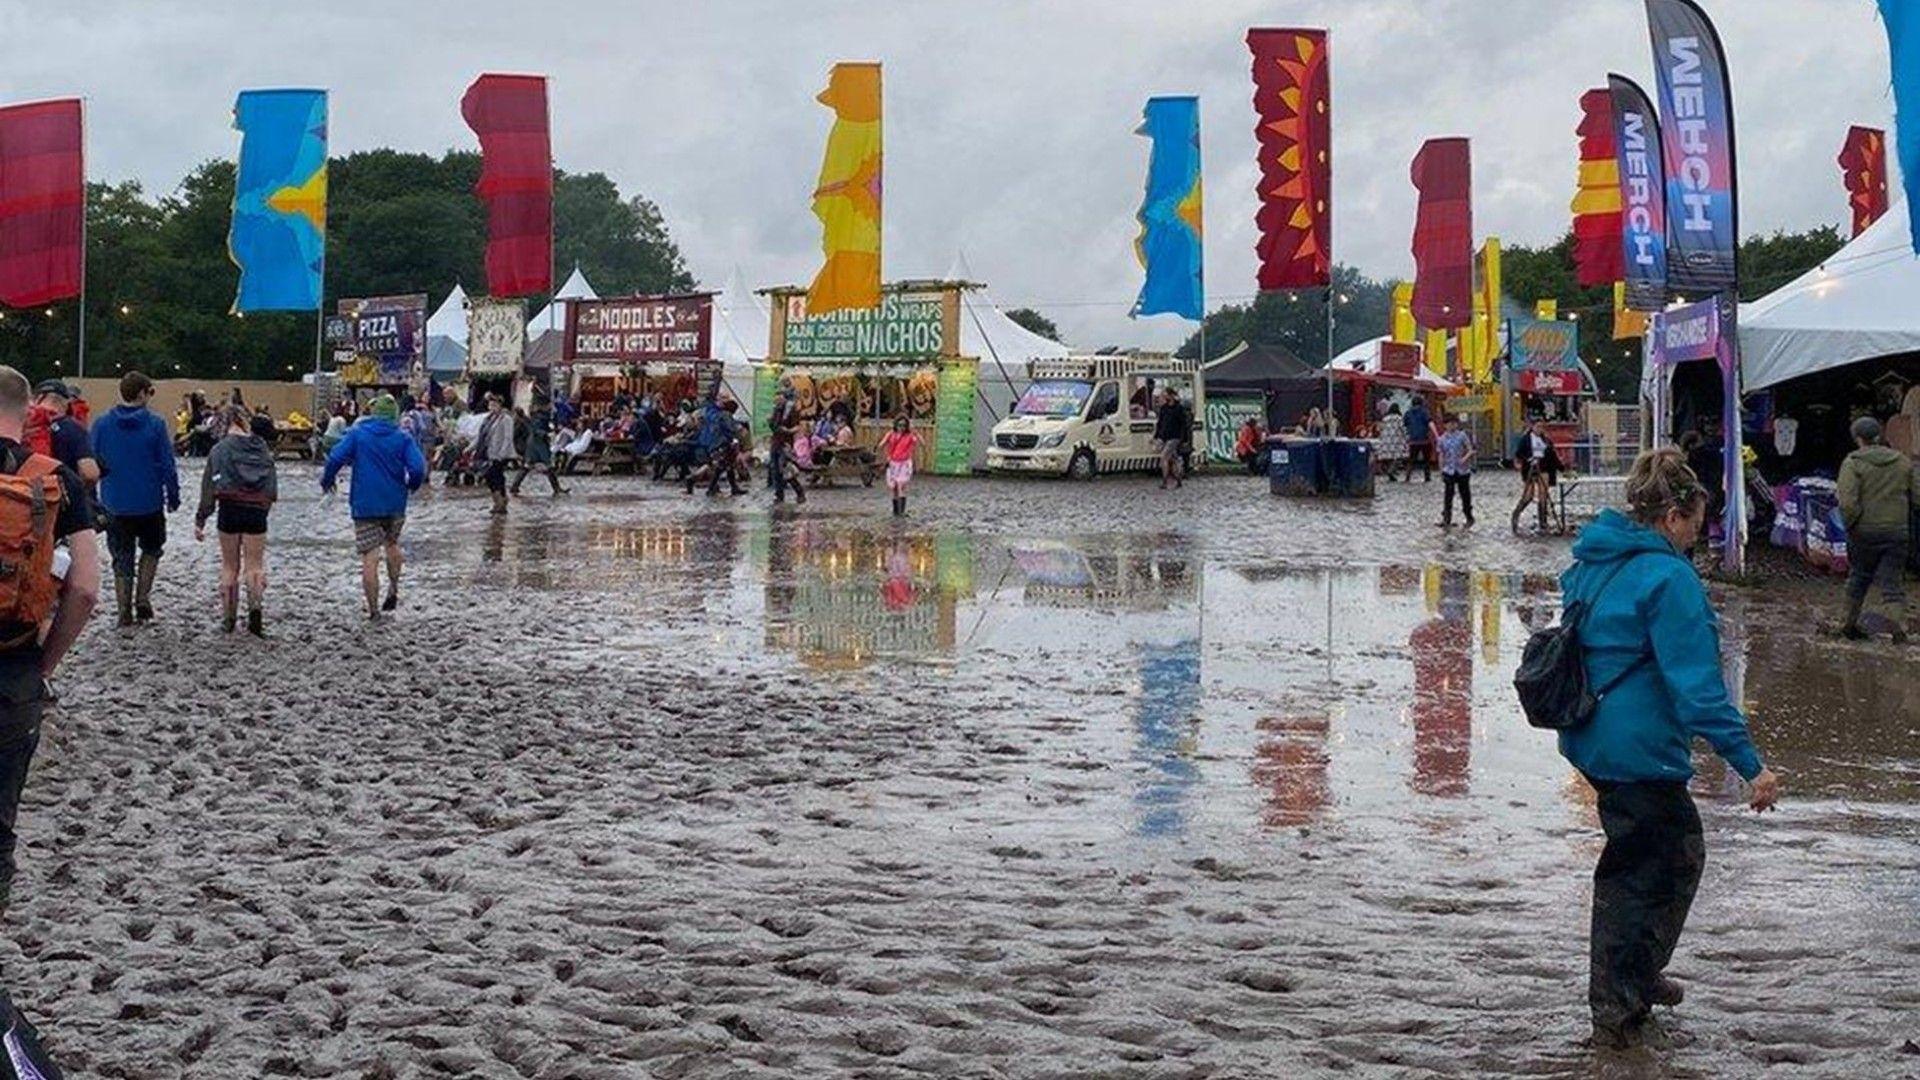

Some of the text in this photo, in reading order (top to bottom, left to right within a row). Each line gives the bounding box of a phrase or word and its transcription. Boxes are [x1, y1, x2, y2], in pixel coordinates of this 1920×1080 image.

[1624, 112, 1654, 265] MERCH
[600, 306, 676, 329] NOODLES
[900, 302, 944, 320] WRAPS
[359, 316, 398, 339] PIZZA
[856, 321, 943, 353] NACHOS
[359, 338, 400, 351] SLICES
[576, 334, 621, 352] CHICKEN
[661, 332, 700, 351] CURRY
